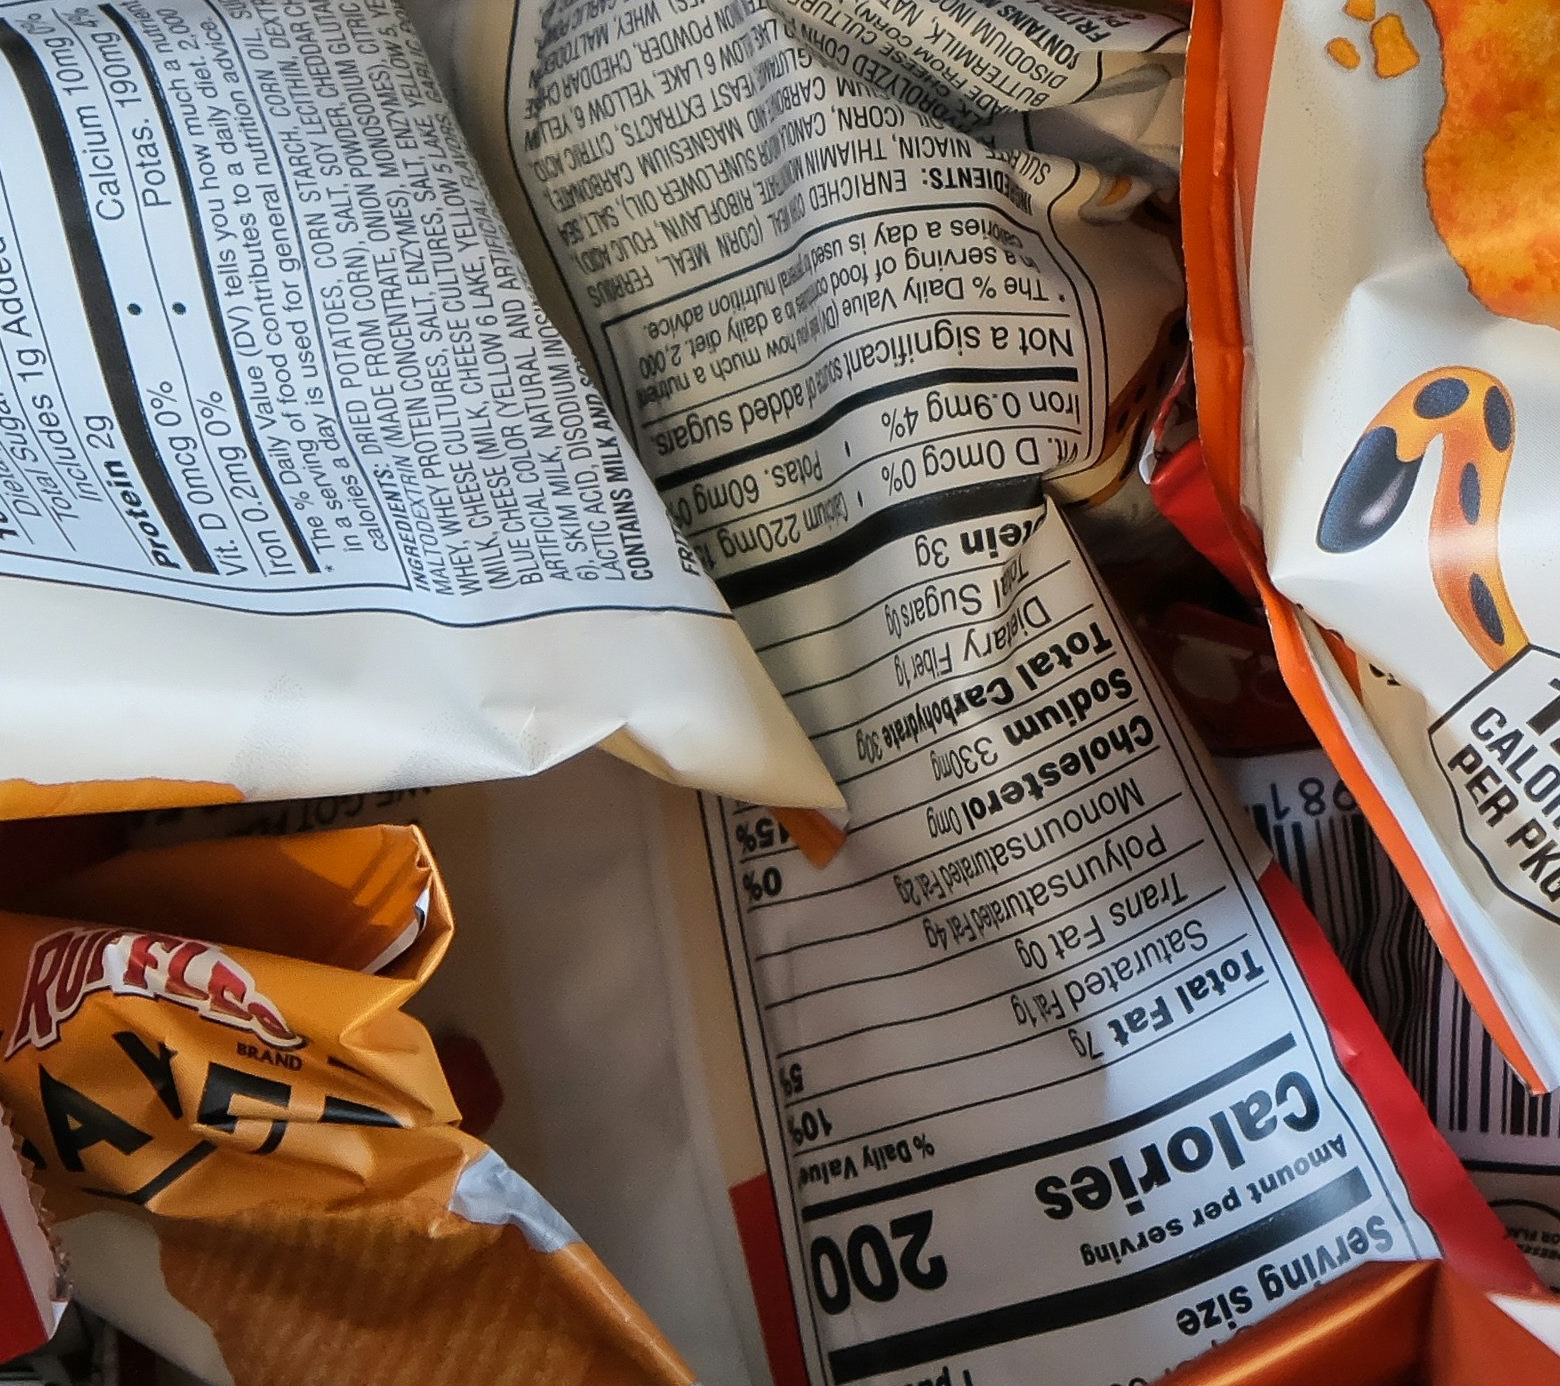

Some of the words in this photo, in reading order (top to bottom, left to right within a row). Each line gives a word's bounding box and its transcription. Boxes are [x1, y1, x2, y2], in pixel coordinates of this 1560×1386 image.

[42, 37, 90, 96] 10mg
[78, 105, 126, 222] Calcium
[1447, 745, 1519, 827] PER
[5, 928, 302, 1051] RUFFLES
[1174, 948, 1265, 1015] Total
[1073, 1027, 1098, 1061] 7g
[1109, 1001, 1168, 1048] Fat
[1034, 1068, 1322, 1221] Calories
[810, 1211, 948, 1315] 200
